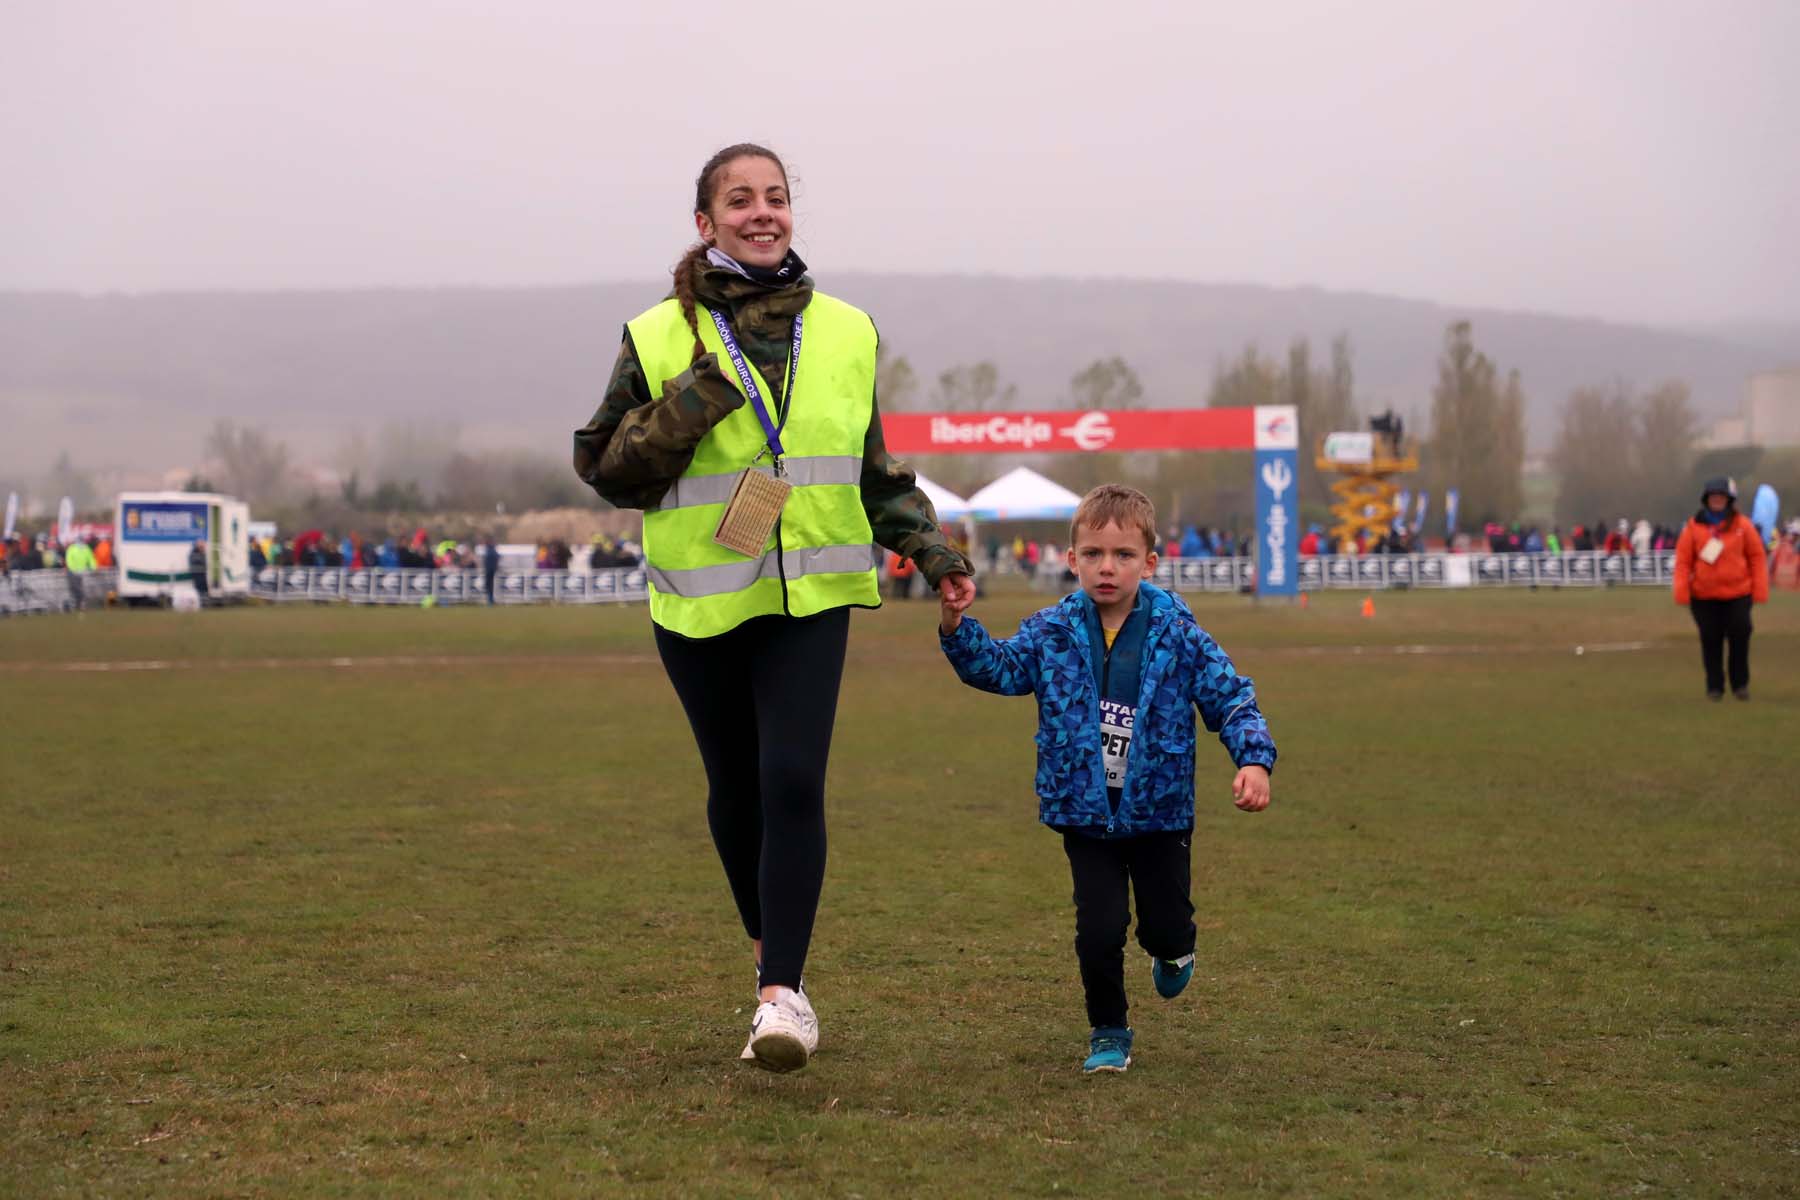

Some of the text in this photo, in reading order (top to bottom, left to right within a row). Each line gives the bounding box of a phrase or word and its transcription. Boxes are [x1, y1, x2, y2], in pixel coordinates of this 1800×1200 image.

[794, 325, 802, 338] DE
[727, 343, 738, 358] DE
[733, 358, 758, 399] BURGOS
